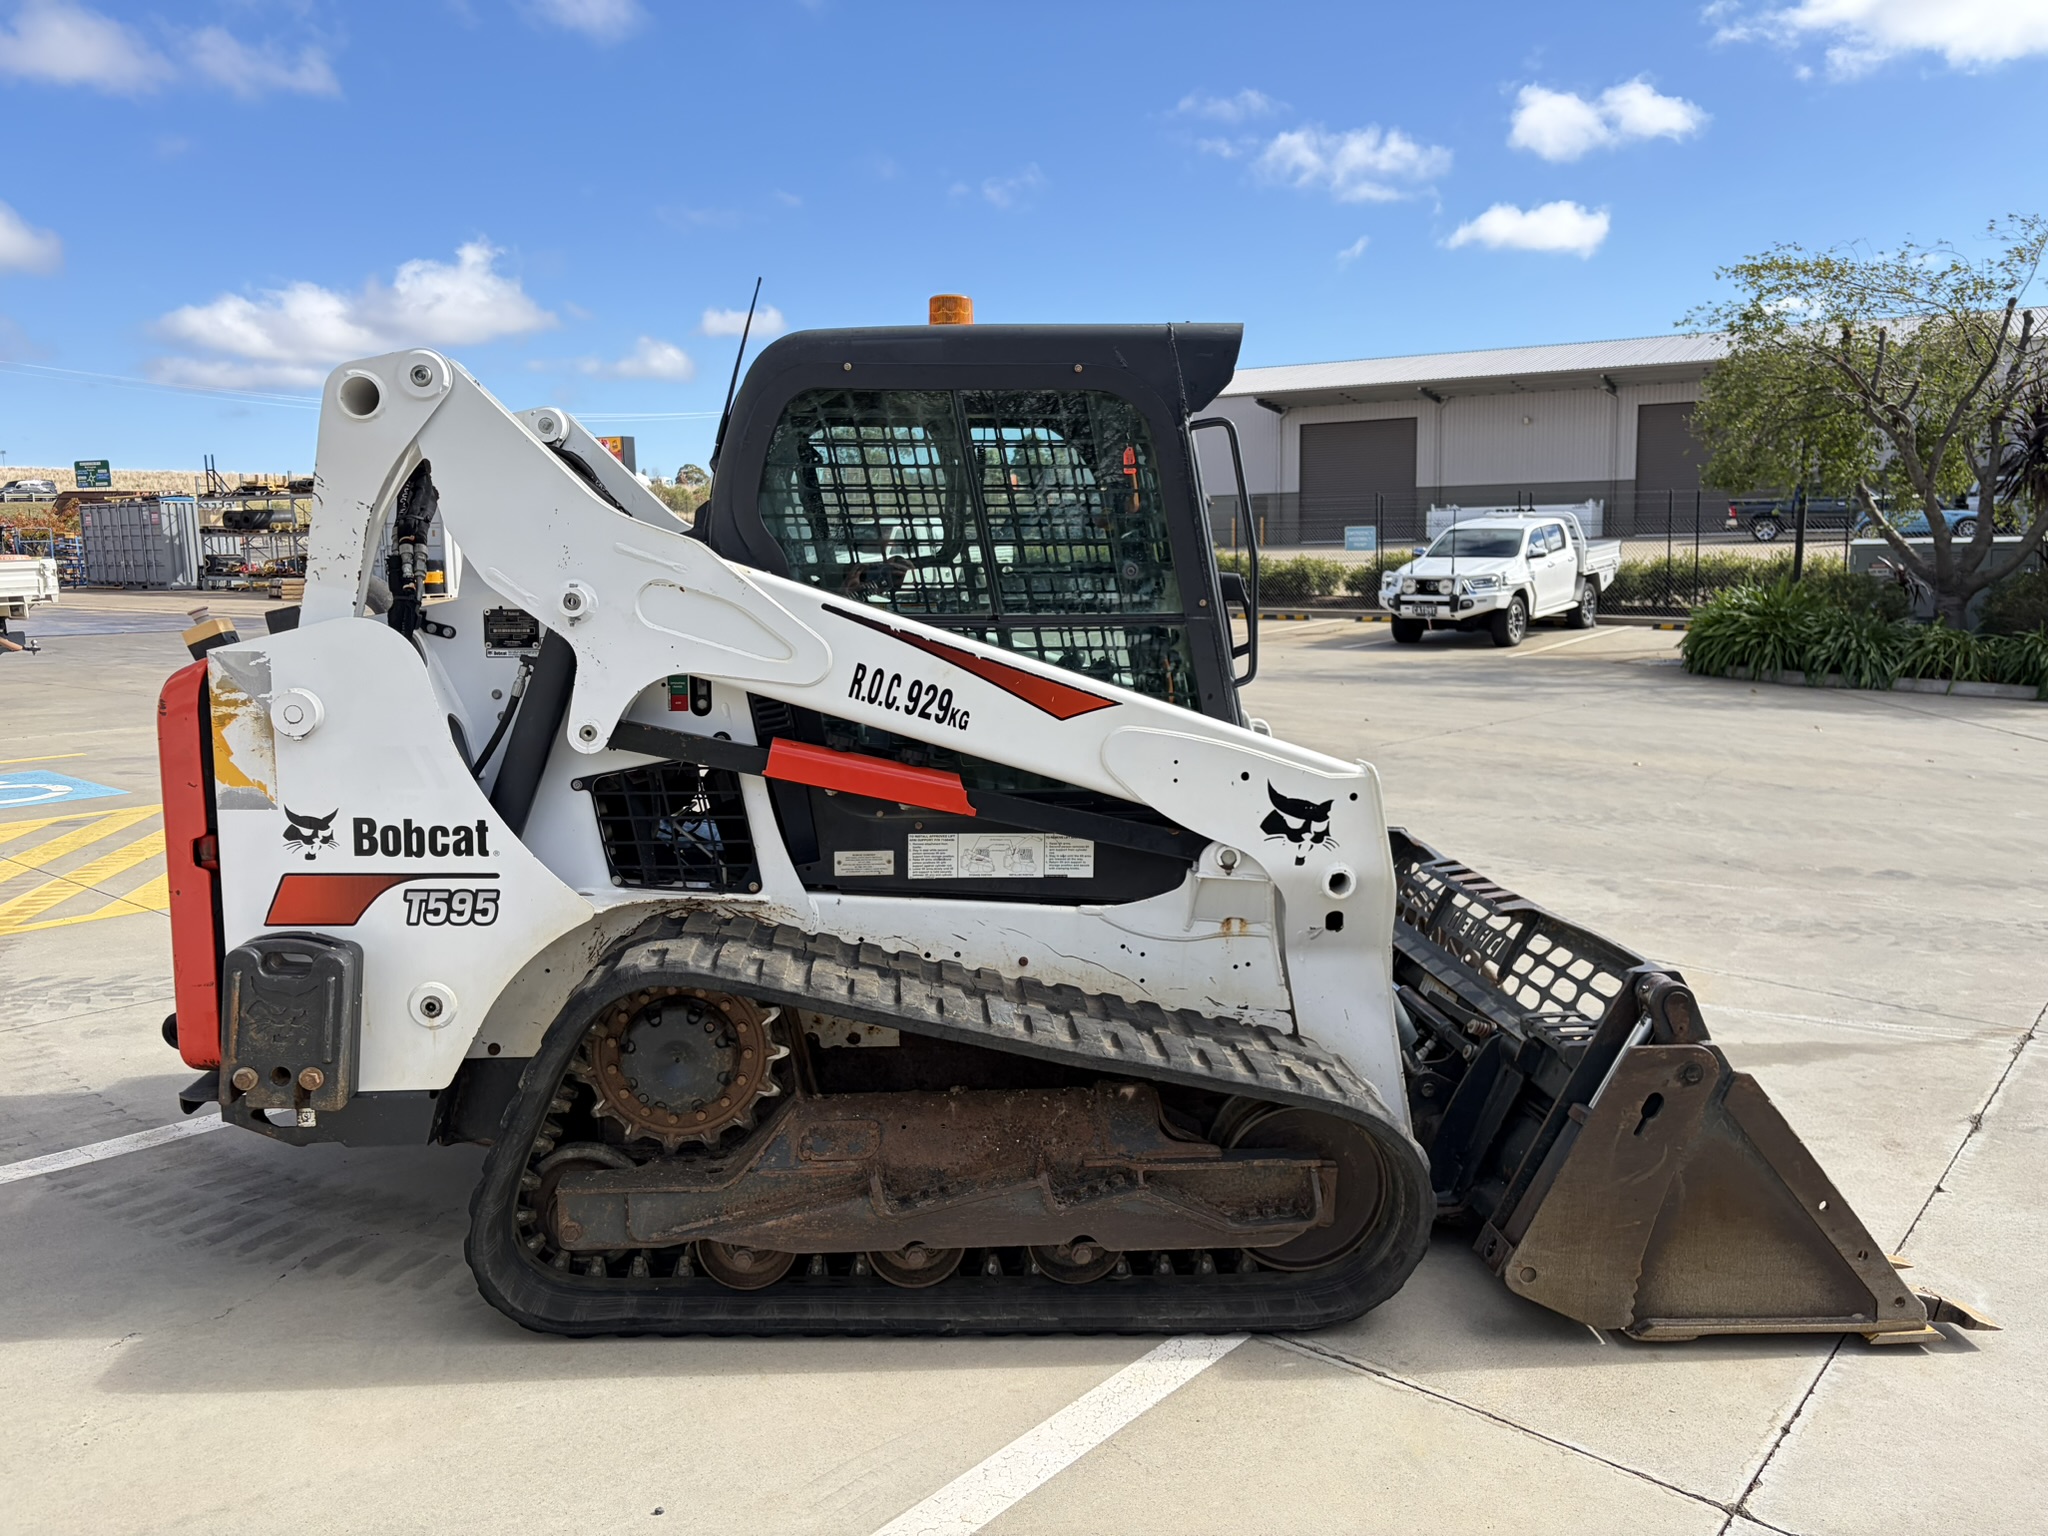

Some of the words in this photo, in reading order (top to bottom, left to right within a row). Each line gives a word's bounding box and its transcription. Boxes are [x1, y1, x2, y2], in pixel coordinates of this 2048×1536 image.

[848, 662, 902, 712] R.O.C.
[353, 817, 489, 858] Bobcat
[403, 889, 501, 926] T595
